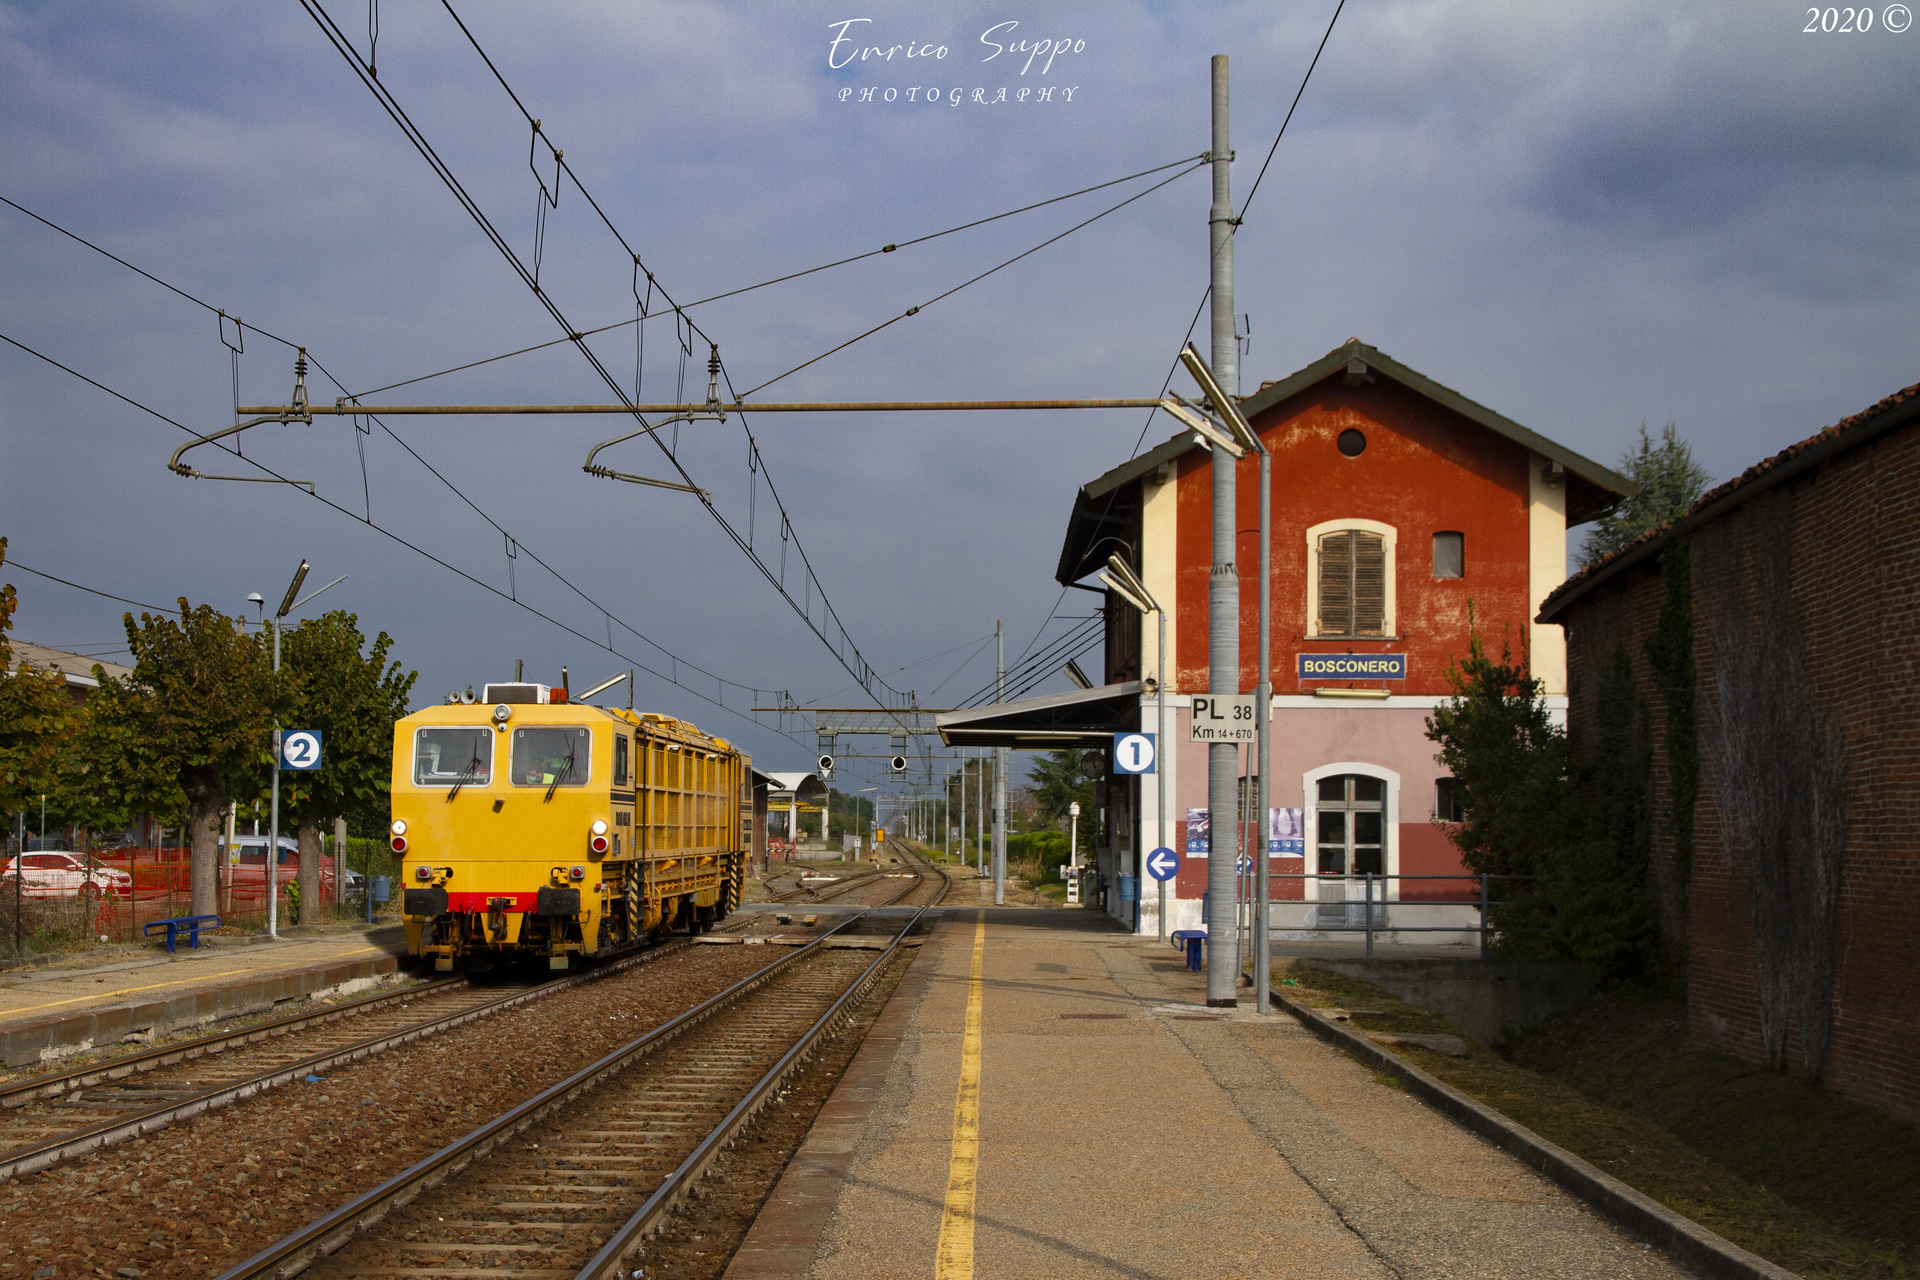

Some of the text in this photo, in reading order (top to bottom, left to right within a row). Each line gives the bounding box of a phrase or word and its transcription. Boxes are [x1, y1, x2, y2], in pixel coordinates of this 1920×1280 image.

[1304, 660, 1401, 673] BOSCONERO
[1193, 698, 1252, 720] PL 38
[1192, 725, 1214, 738] Km
[293, 738, 310, 761] 2
[1130, 742, 1139, 765] 1
